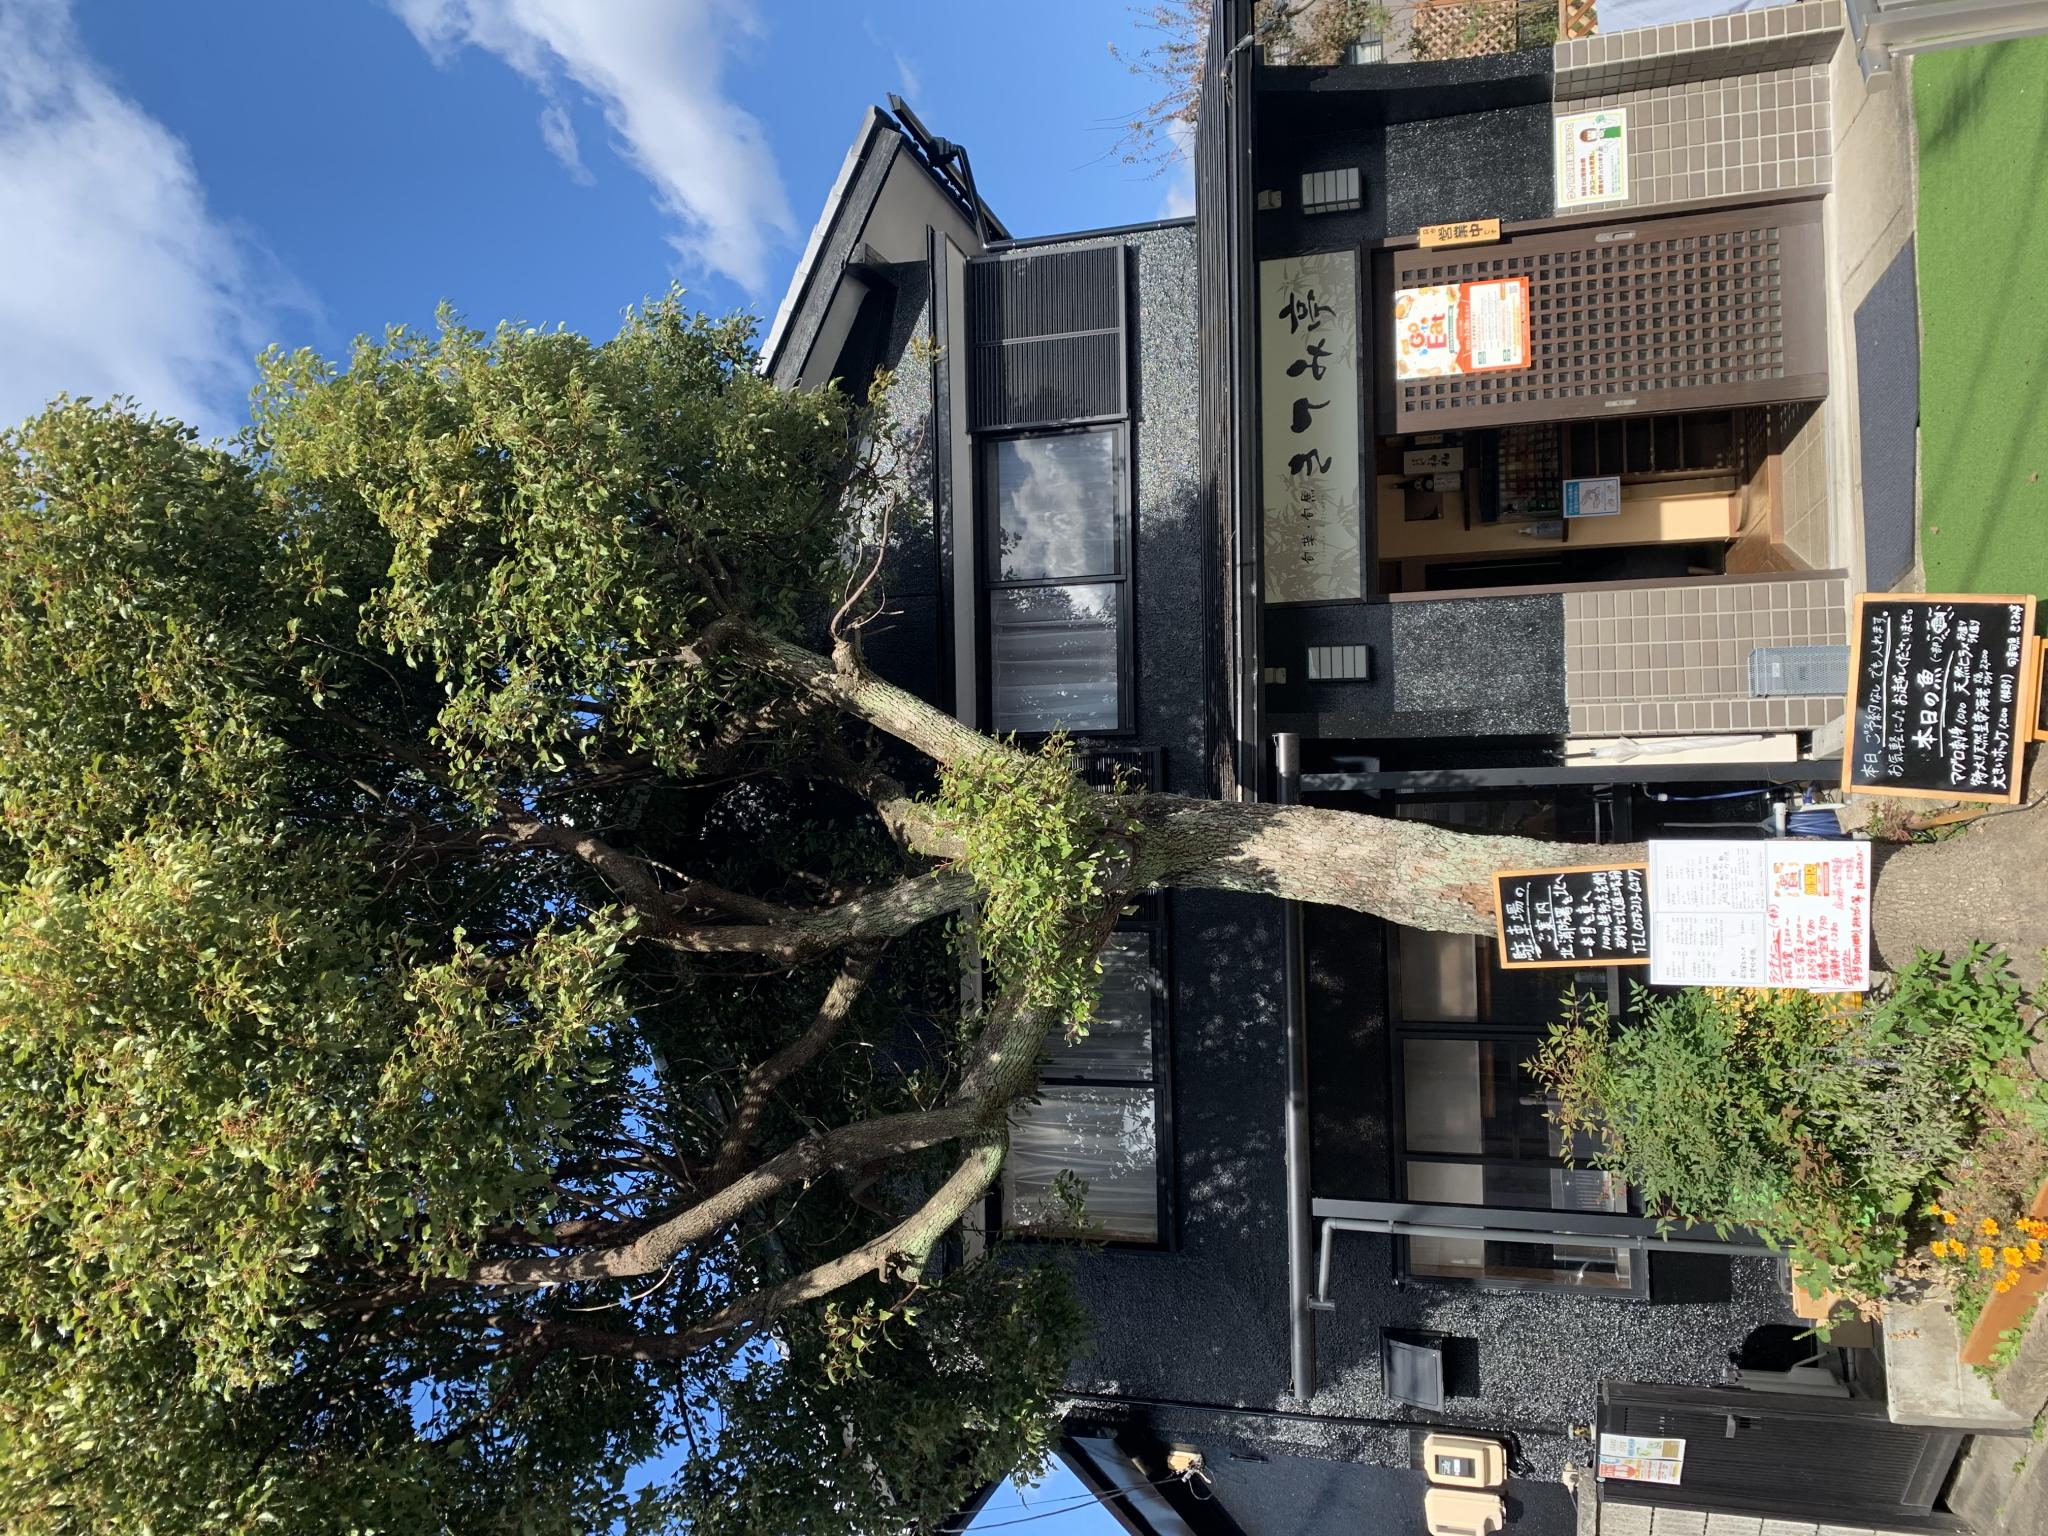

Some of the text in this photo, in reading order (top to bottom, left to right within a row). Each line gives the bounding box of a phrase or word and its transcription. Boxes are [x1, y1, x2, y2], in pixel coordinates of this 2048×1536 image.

[1407, 322, 1425, 349] Go
[1426, 313, 1447, 350] Eat
[1279, 290, 1336, 475] きてみ亭
[1911, 667, 1943, 750] 本日の魚
[1505, 887, 1535, 961] 駐車場の
[1535, 901, 1553, 942] ご案内
[1575, 891, 1596, 957] 一本目を東へ
